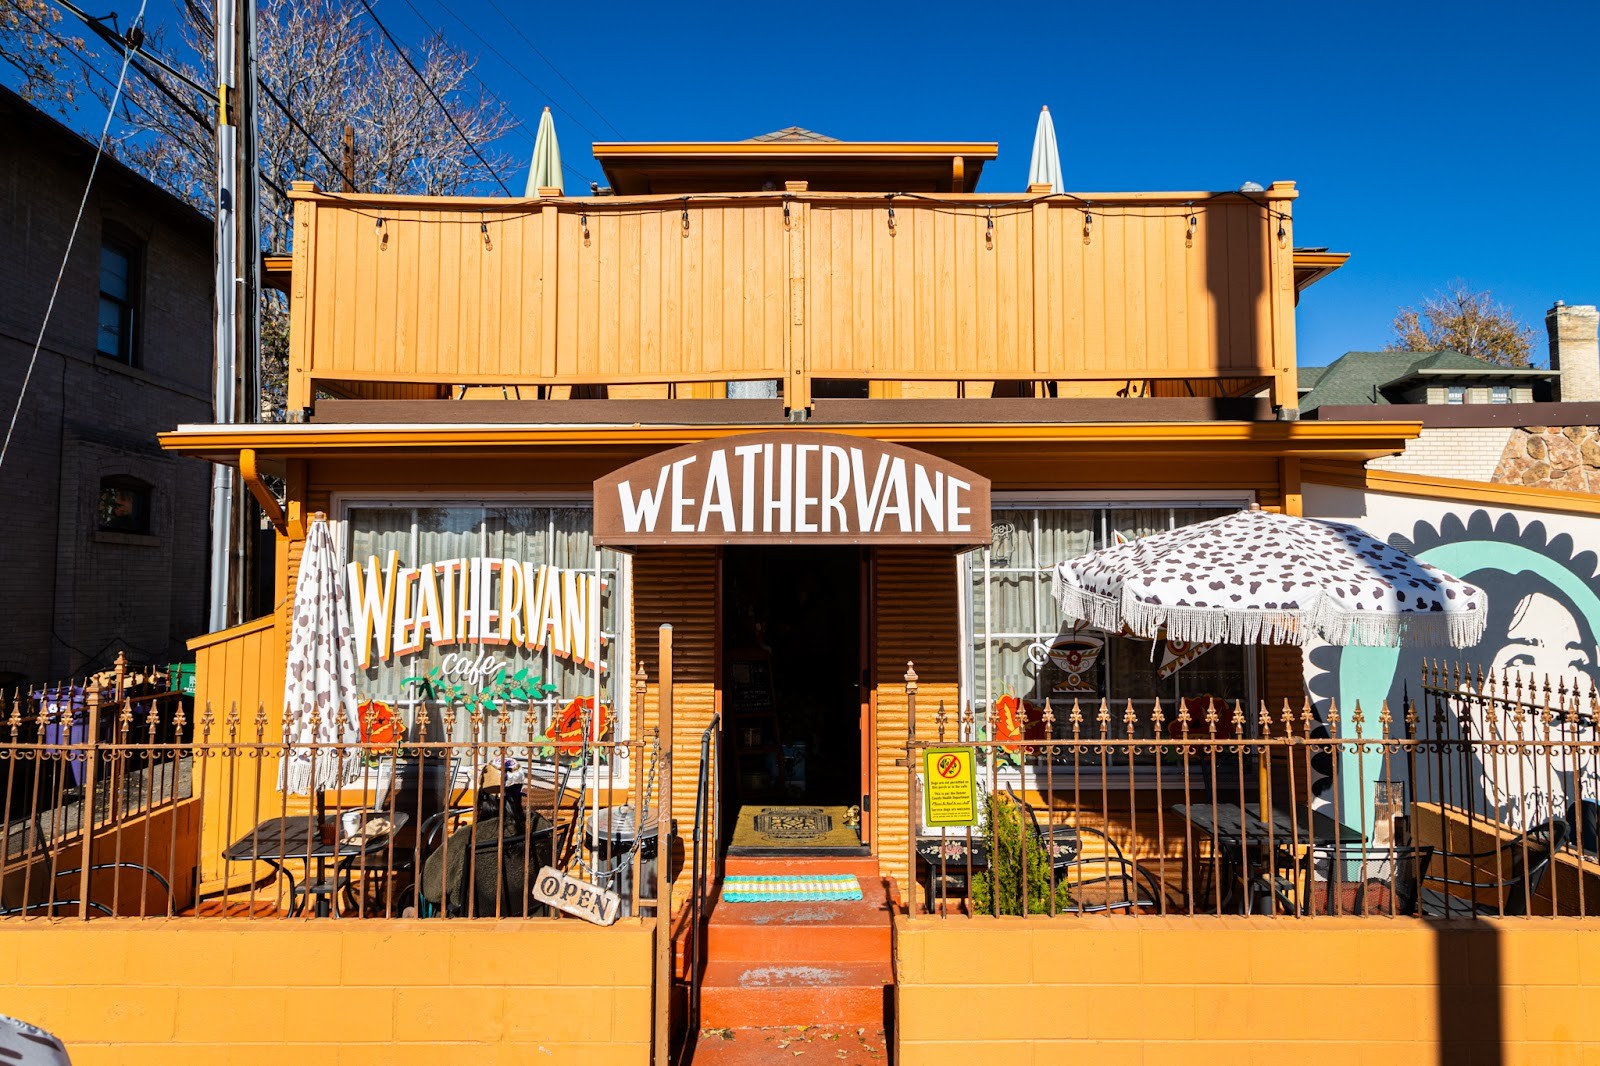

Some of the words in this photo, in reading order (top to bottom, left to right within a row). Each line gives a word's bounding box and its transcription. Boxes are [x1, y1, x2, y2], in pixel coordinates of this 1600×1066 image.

[617, 443, 971, 533] WEATHERVANE
[441, 649, 506, 685] cafe
[541, 876, 611, 920] OPEN
